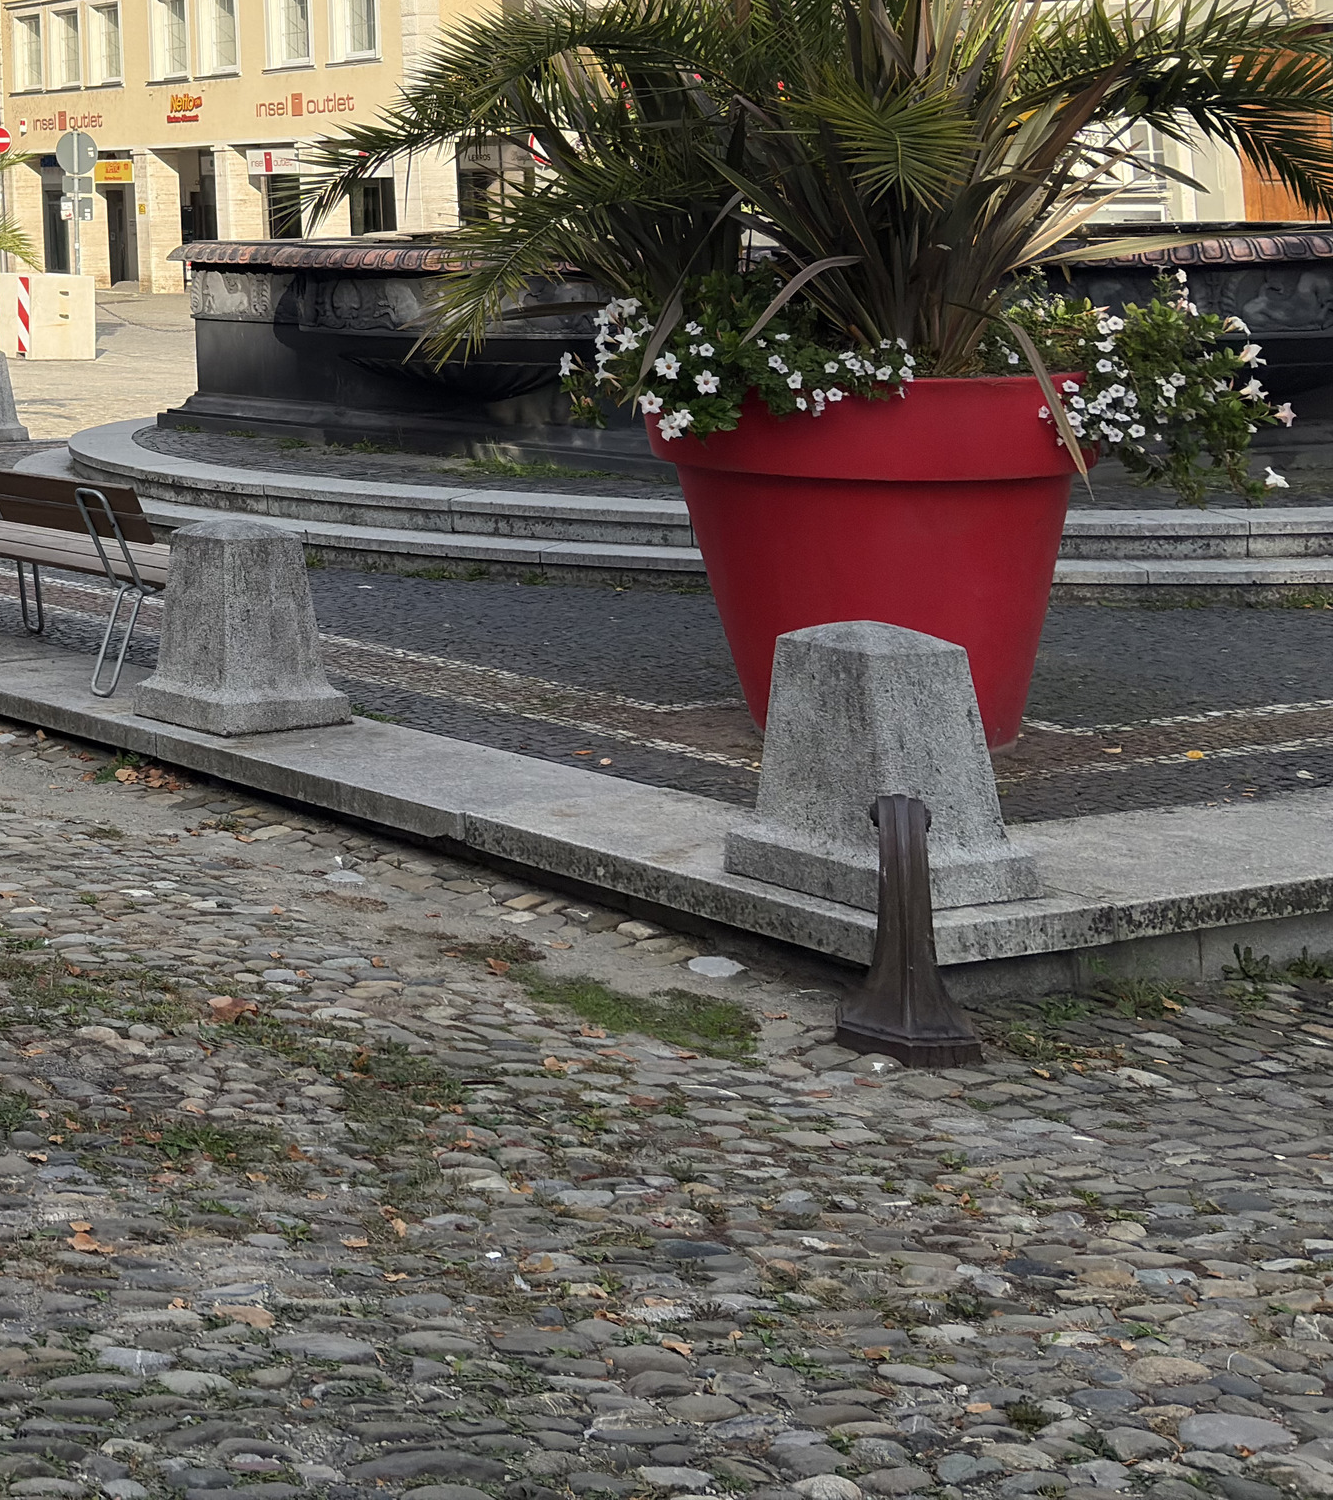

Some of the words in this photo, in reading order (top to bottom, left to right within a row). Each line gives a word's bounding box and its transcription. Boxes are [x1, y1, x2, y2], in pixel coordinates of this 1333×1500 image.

[170, 93, 195, 113] Netto
[256, 96, 288, 117] insel
[306, 92, 355, 114] outlet
[33, 115, 57, 131] insel
[68, 111, 103, 130] outlet
